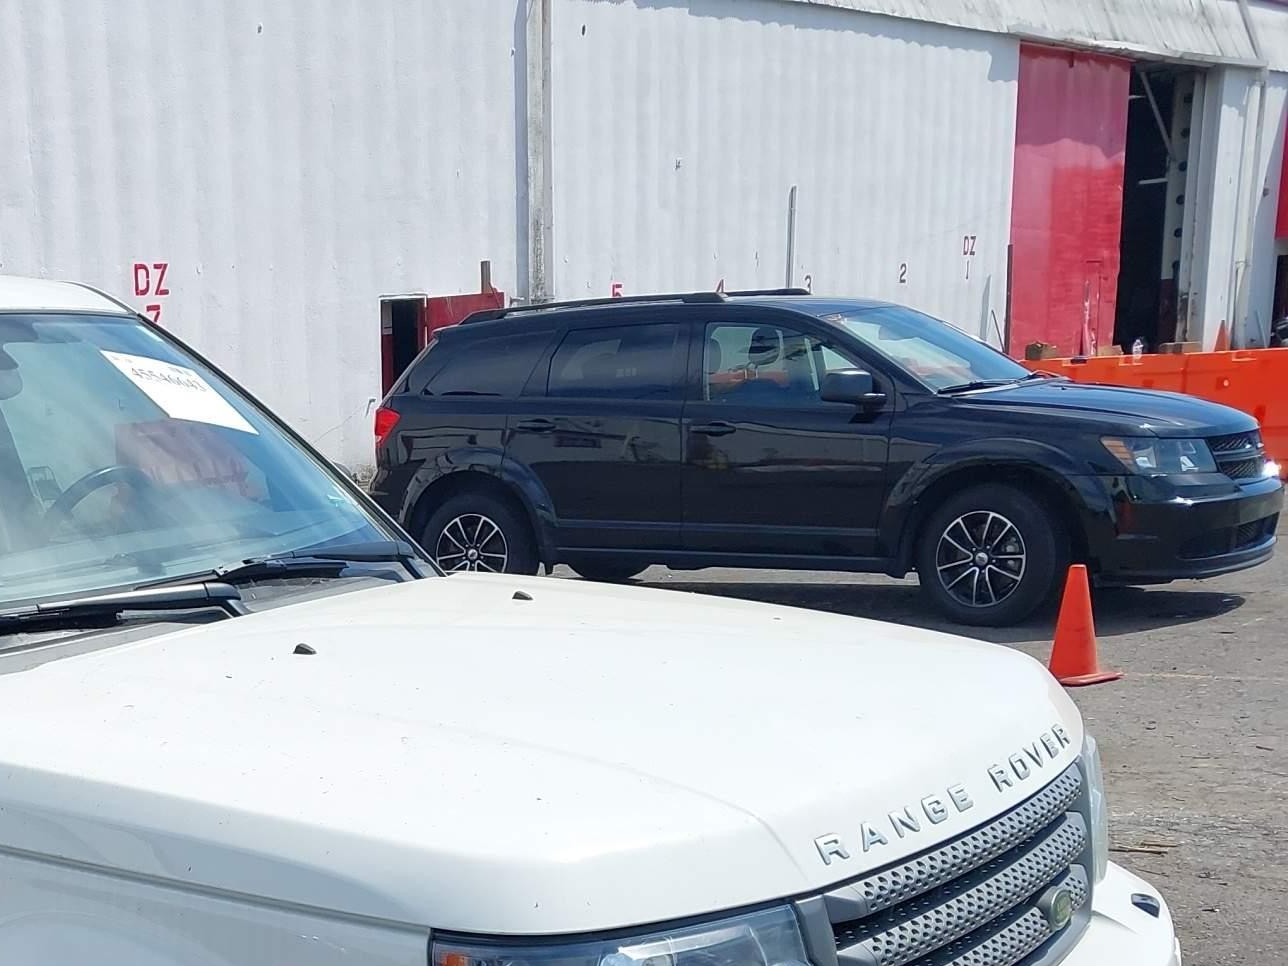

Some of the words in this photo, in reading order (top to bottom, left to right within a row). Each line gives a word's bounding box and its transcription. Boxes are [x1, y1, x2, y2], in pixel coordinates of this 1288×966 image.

[962, 235, 977, 256] DZ
[134, 263, 170, 296] DZ
[898, 262, 907, 283] 2
[146, 304, 161, 323] 7
[814, 782, 974, 866] RANGE
[987, 723, 1071, 793] ROVER
